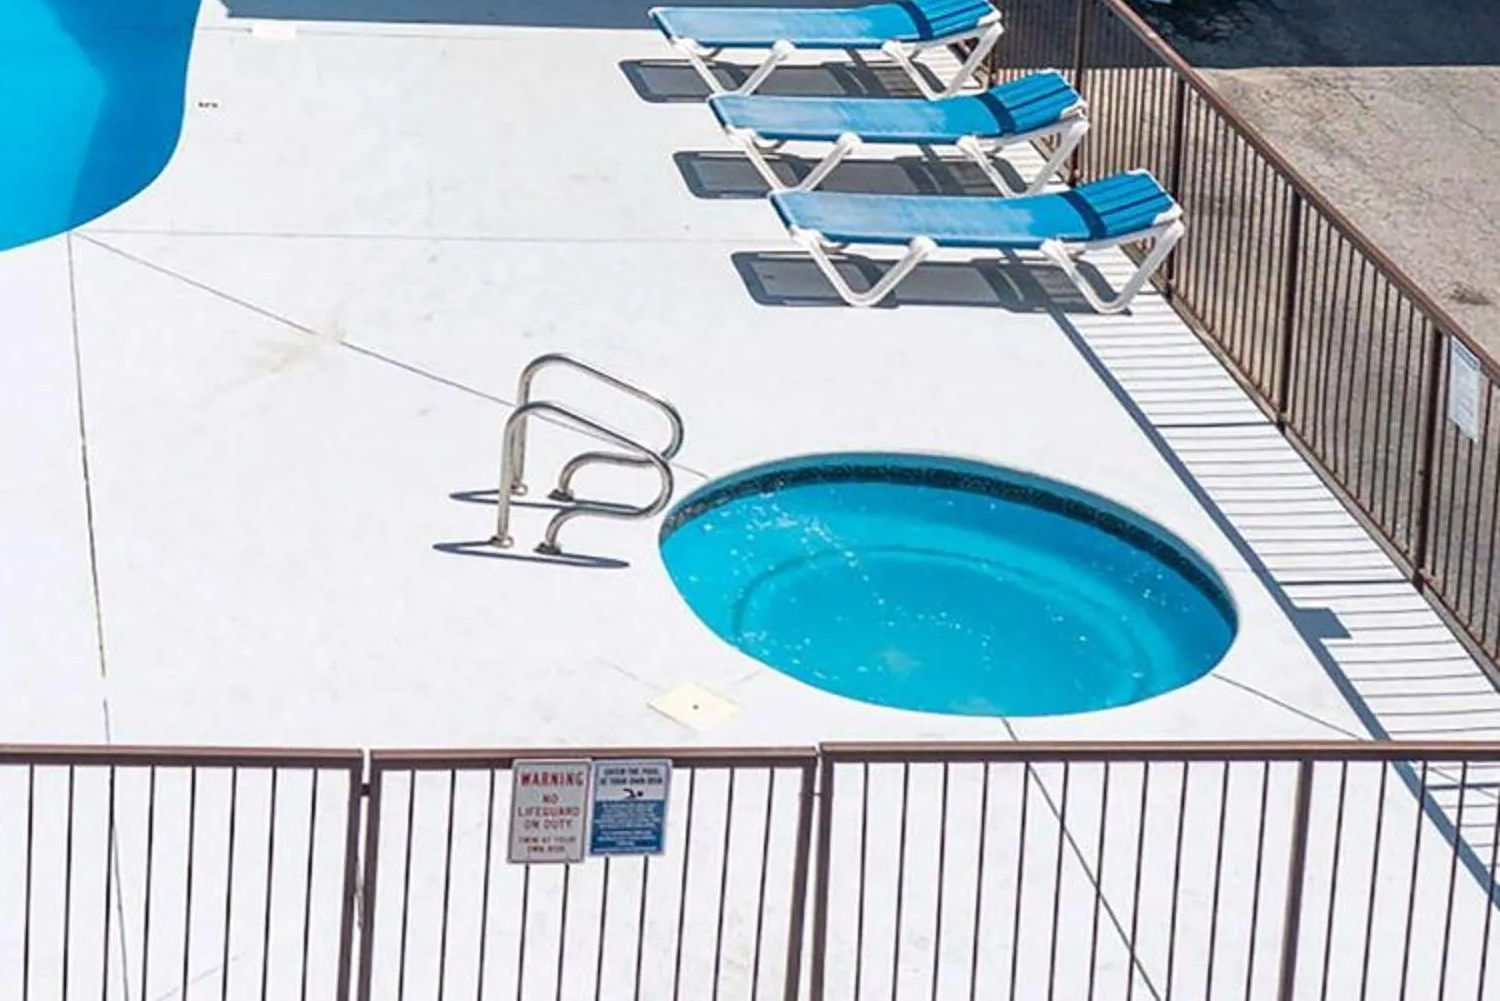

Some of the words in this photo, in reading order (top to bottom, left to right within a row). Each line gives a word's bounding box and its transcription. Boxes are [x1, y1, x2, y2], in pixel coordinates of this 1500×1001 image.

[520, 771, 584, 787] WARNING
[543, 793, 559, 804] NO
[518, 806, 580, 817] LIFEGUARD
[524, 819, 540, 830] ON
[544, 819, 572, 830] DUTY
